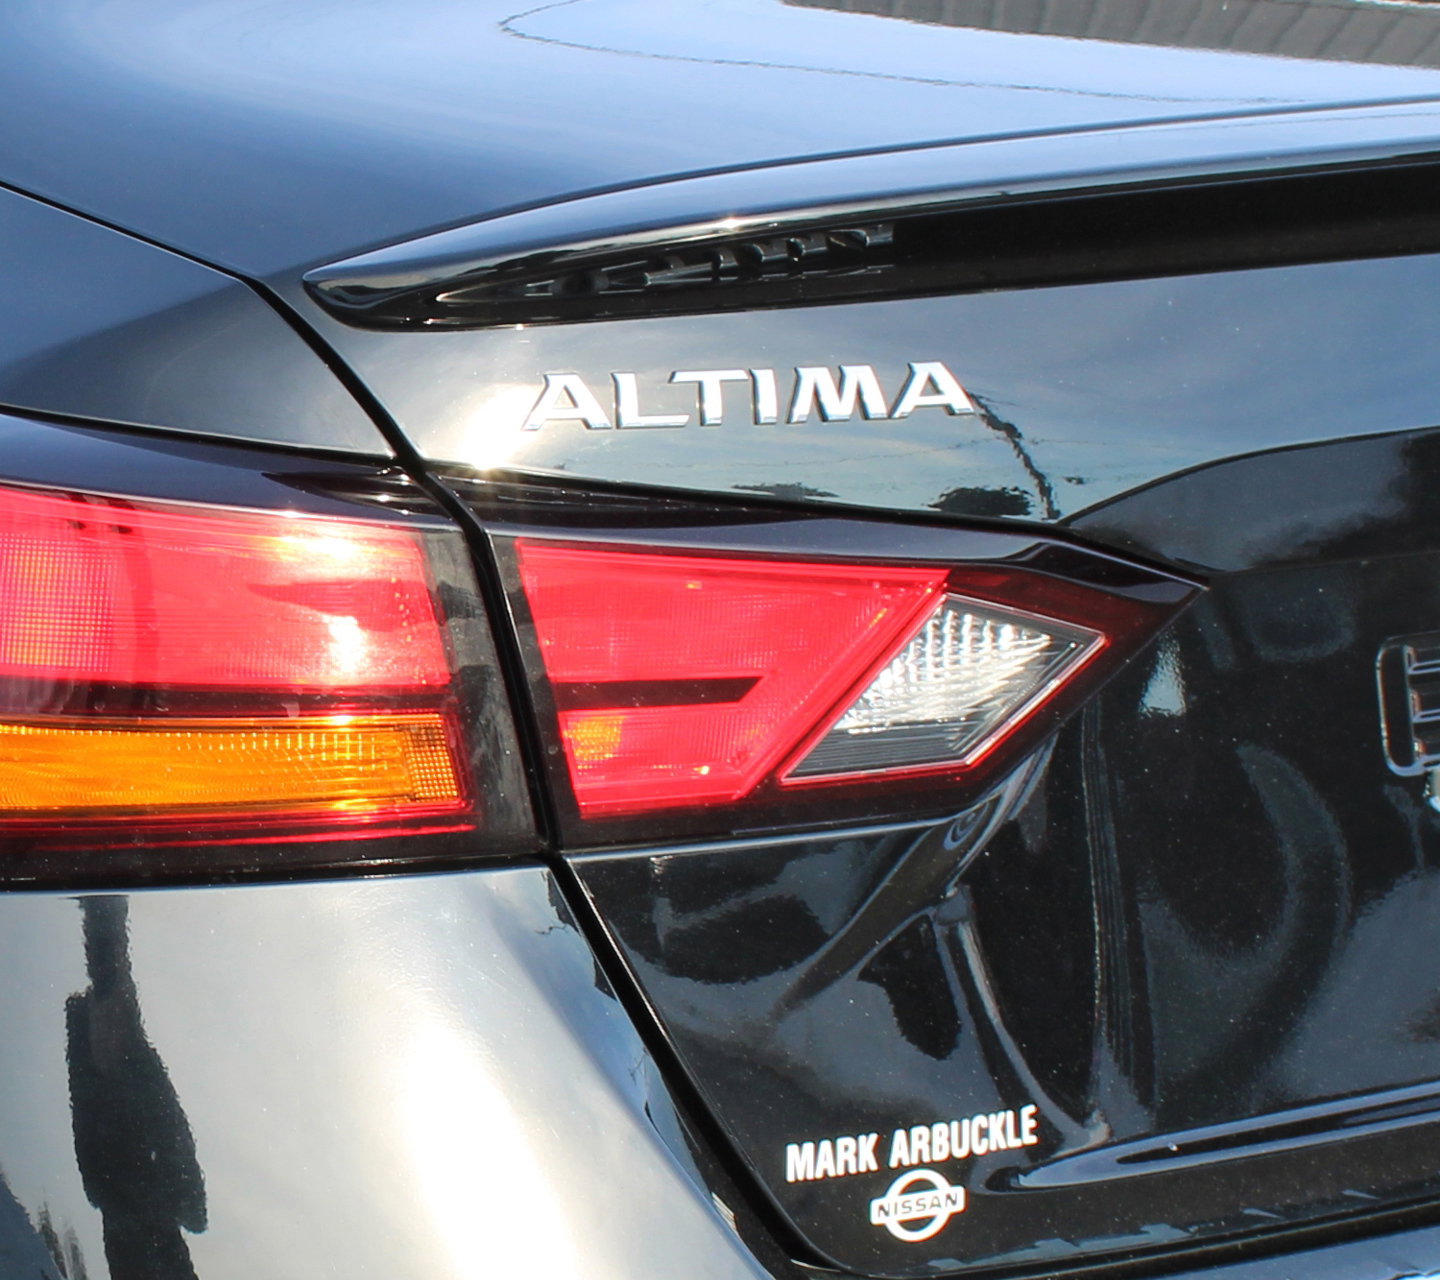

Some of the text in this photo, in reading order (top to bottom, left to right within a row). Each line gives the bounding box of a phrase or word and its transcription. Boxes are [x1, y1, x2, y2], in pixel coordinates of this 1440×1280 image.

[522, 359, 977, 431] ALTIMA
[784, 1103, 1040, 1183] MARK ARBUCKLE
[876, 1192, 959, 1219] NISSAN
